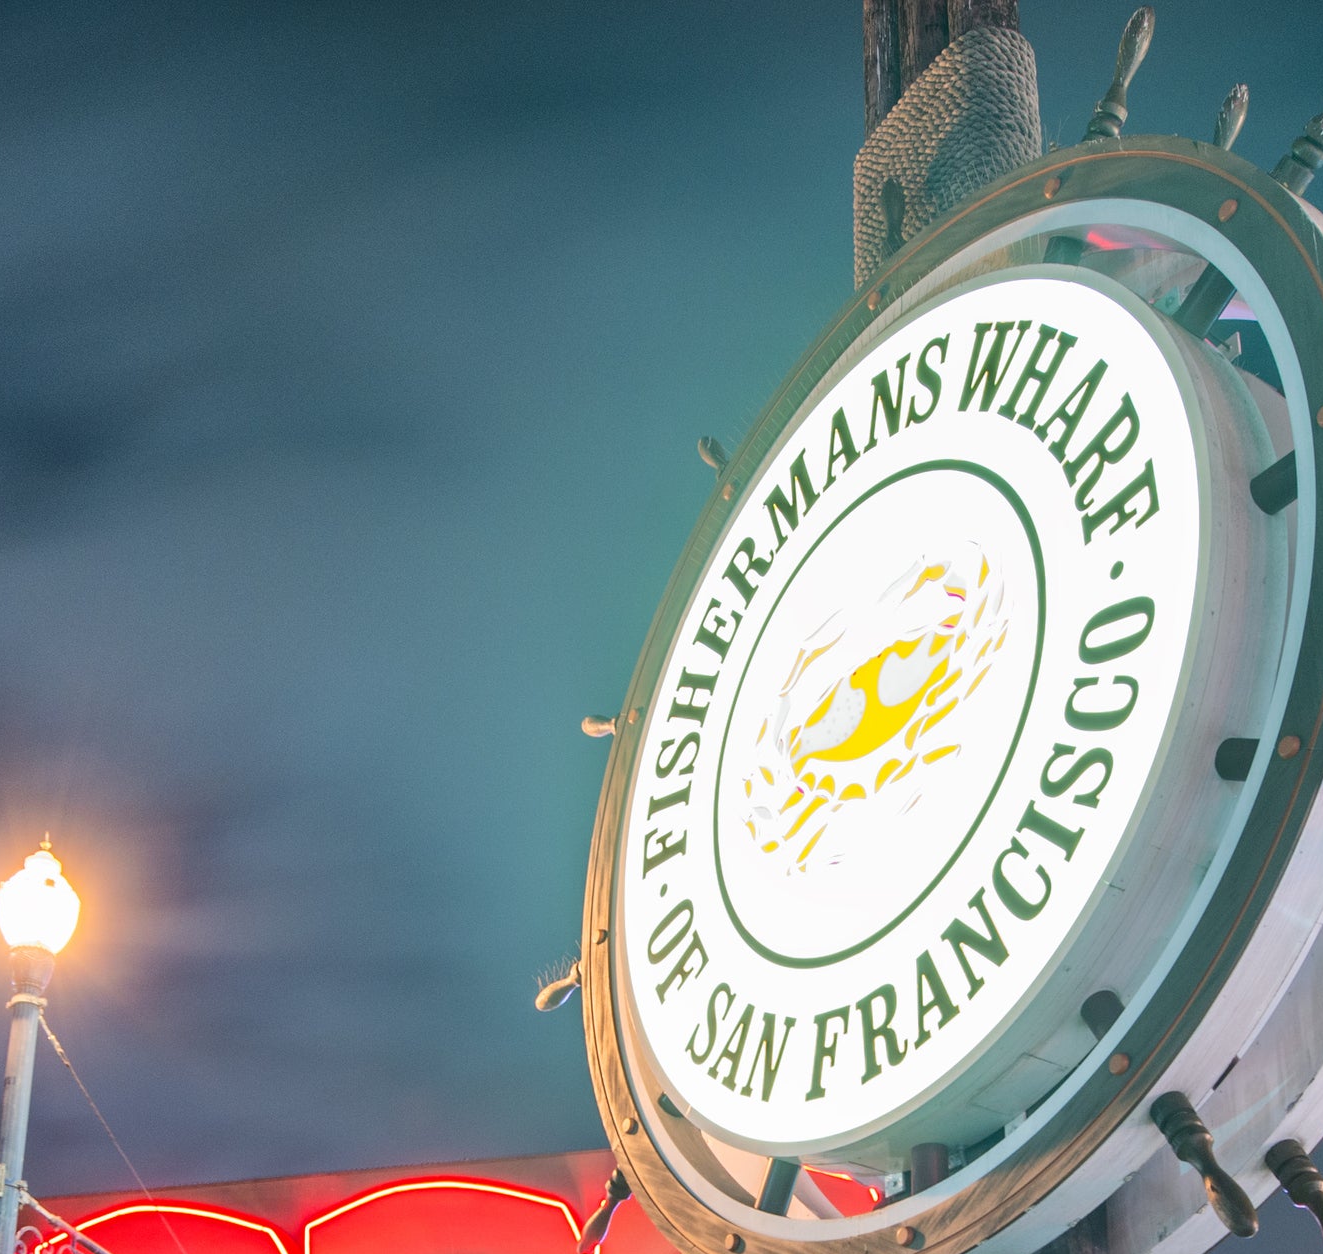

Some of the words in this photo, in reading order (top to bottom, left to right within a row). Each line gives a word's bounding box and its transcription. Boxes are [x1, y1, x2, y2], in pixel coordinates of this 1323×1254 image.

[641, 331, 951, 880] FISHERMANS
[956, 318, 1161, 546] WHARF
[646, 898, 709, 1005] OF
[685, 981, 796, 1103] SAN
[804, 594, 1156, 1103] FRANCISCO
